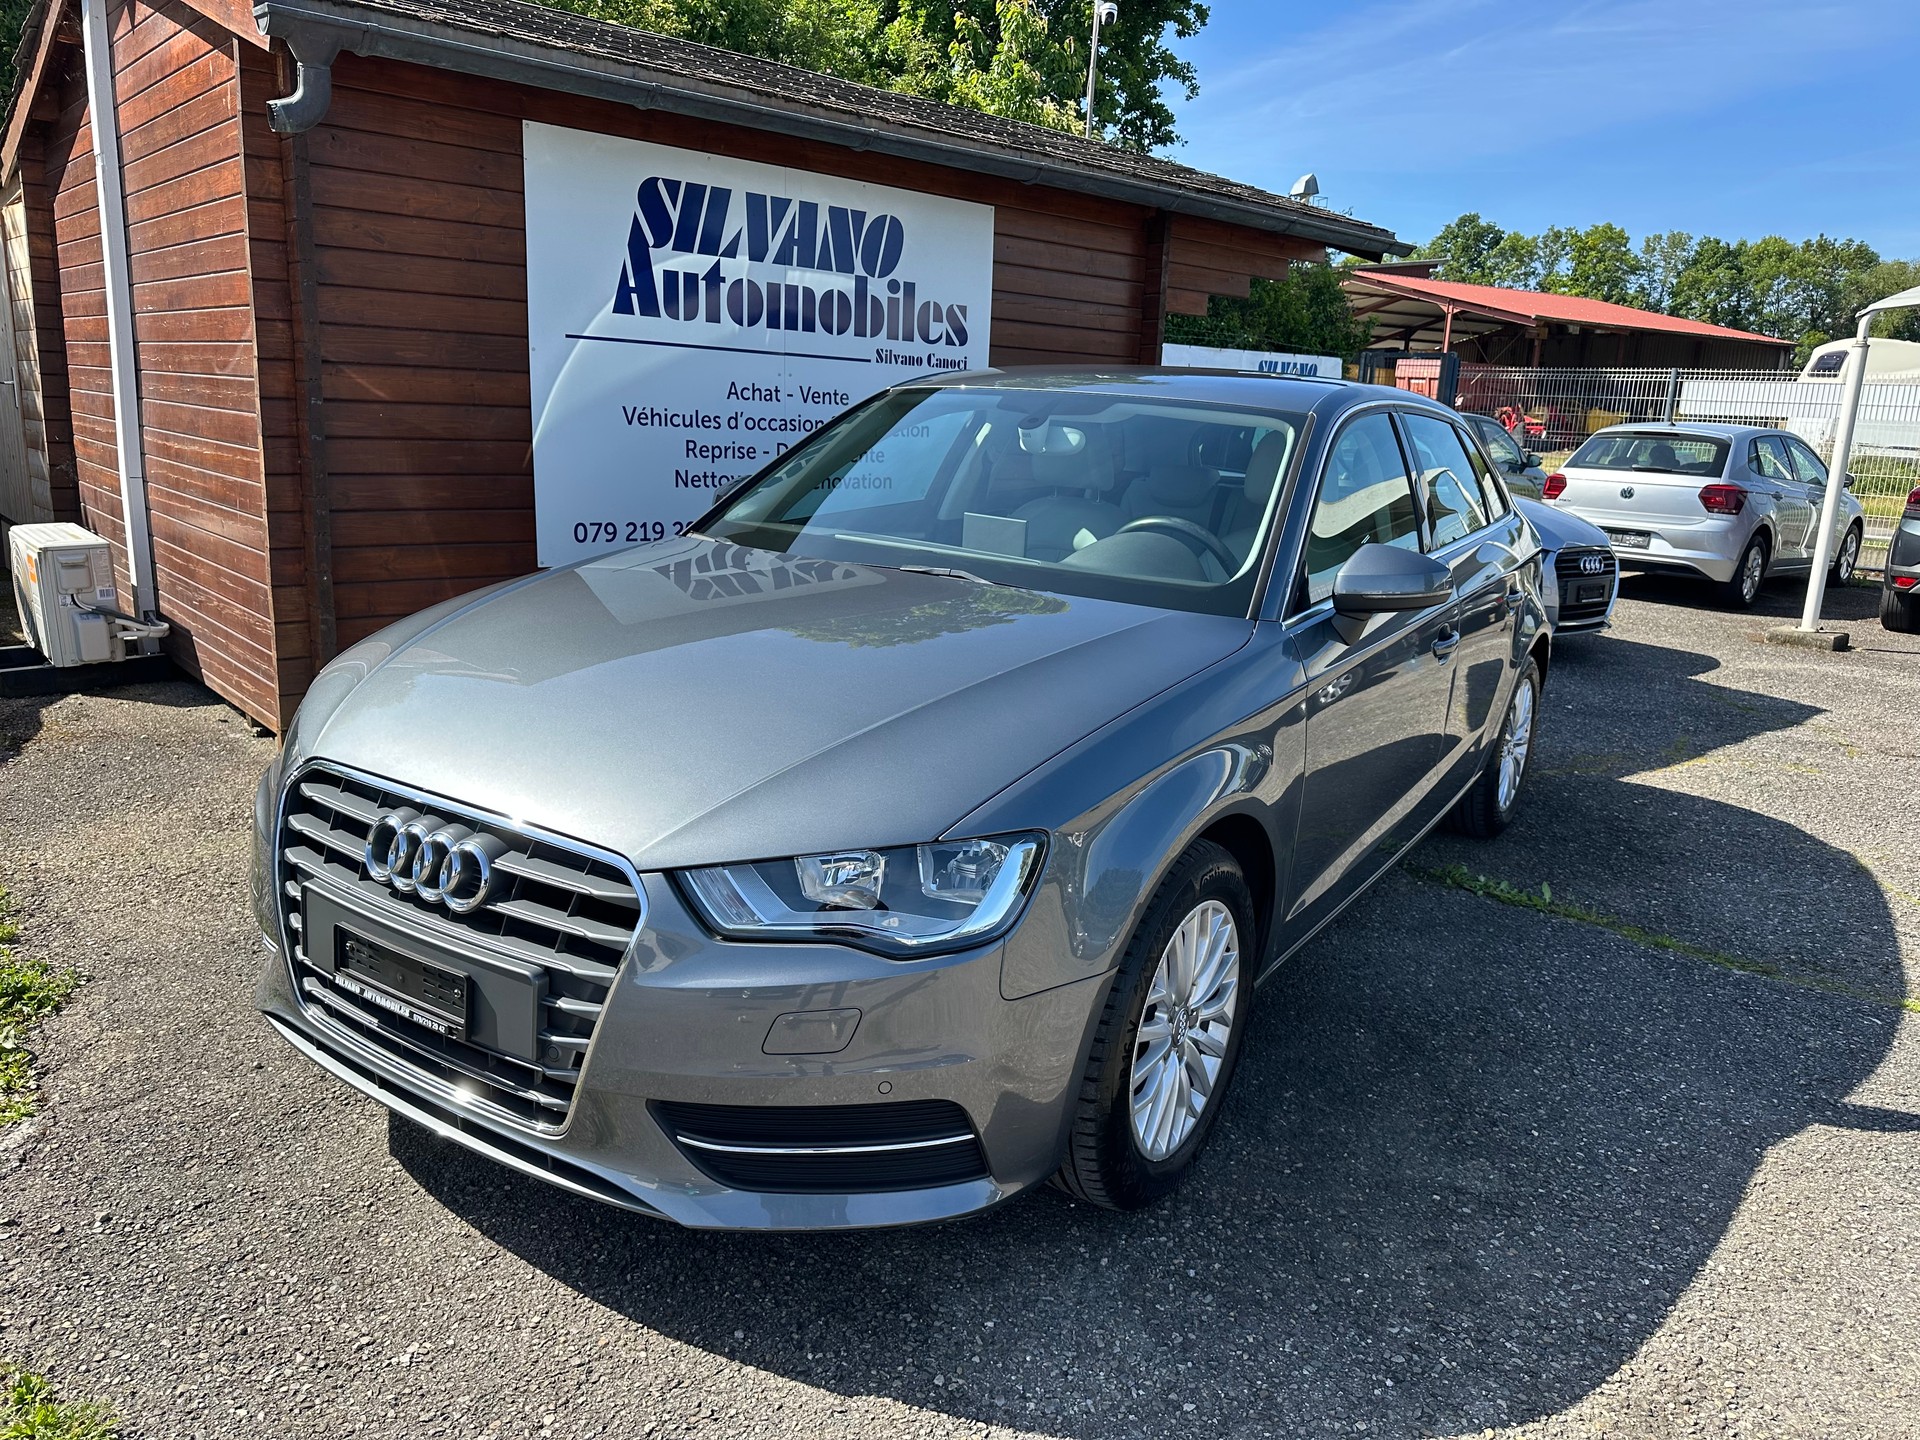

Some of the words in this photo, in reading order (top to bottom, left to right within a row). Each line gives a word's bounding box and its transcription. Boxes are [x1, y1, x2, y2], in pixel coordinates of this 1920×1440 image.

[637, 176, 905, 279] SILVANO
[612, 211, 969, 347] Automobiles
[875, 348, 923, 367] Silvano
[926, 353, 968, 370] Canoci
[726, 381, 781, 402] Achat
[799, 385, 850, 406] Vente
[622, 406, 722, 430] Véhicules
[685, 439, 757, 464] Reprise
[573, 522, 618, 543] 079
[625, 521, 665, 542] 219
